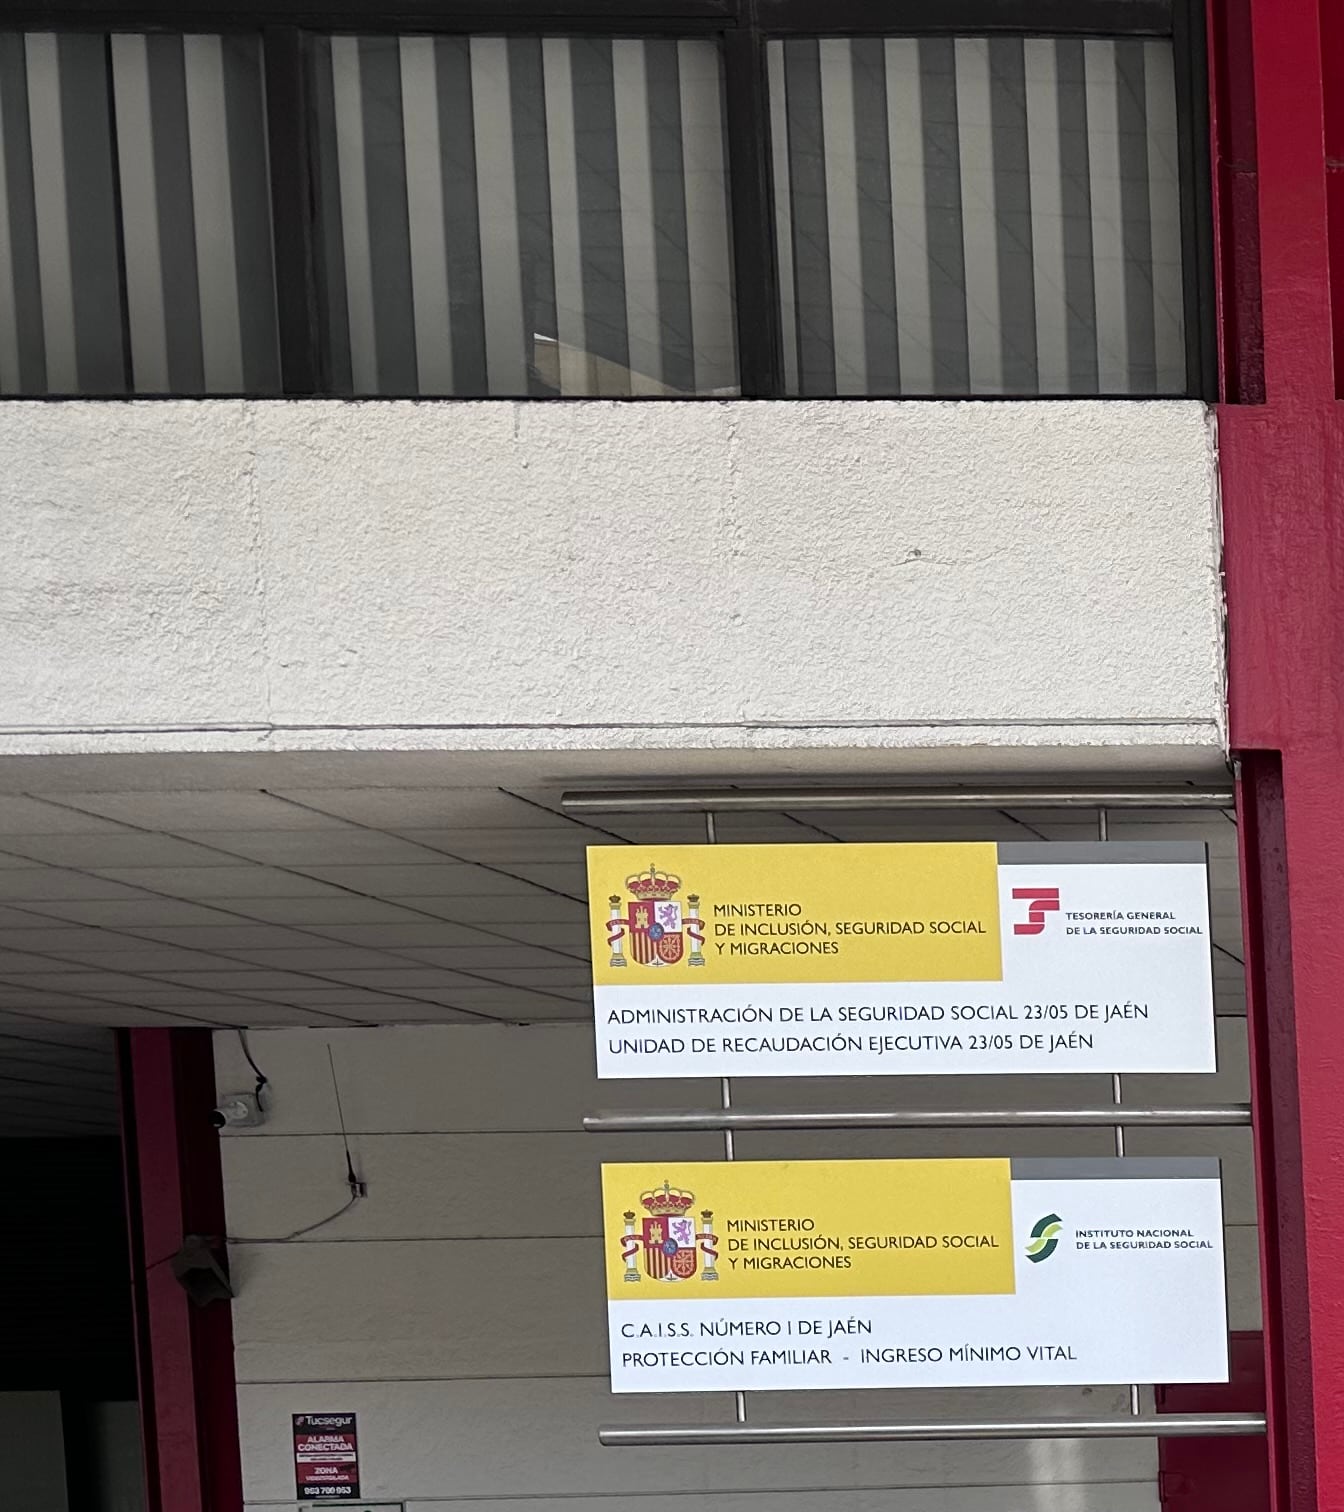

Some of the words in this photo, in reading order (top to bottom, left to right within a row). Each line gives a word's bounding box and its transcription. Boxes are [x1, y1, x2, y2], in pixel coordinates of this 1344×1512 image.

[714, 903, 802, 917] MINISTERIO
[1065, 910, 1124, 920] TESORERÍA
[1127, 911, 1176, 920] GENERAL
[714, 923, 735, 936] DE
[740, 920, 831, 937] INCLUSIÓN,
[836, 921, 925, 935] SEGURIDAD
[929, 921, 987, 934] SOCIAL
[1066, 927, 1080, 935] DE
[1083, 926, 1097, 935] LA
[1100, 926, 1161, 935] SEGURIDAD
[1164, 926, 1203, 935] SOCIAL
[715, 943, 726, 955] Y
[730, 941, 839, 955] MIGRACIONES
[607, 1004, 773, 1024] ADMINISTRACIÓN
[779, 1007, 803, 1022] DE
[810, 1007, 833, 1022] LA
[838, 1006, 945, 1022] SEGURIDAD
[950, 1005, 1019, 1020] SOCIAL
[1024, 1004, 1068, 1020] 23/05
[1075, 1005, 1099, 1019] DE
[1103, 1001, 1149, 1023] JAÉN
[608, 1038, 685, 1054] UNIDAD
[692, 1038, 716, 1053] DE
[722, 1033, 862, 1053] RECAUDACIÓN
[869, 1035, 963, 1054] EJECUTIVA
[968, 1034, 1013, 1050] 23/05
[1019, 1034, 1044, 1049] DE
[1048, 1031, 1093, 1053] JAÉN
[727, 1218, 815, 1232] MINISTERIO
[1075, 1229, 1134, 1238] INSTITUTO
[1136, 1229, 1194, 1238] NACIONAL
[728, 1238, 749, 1251] DE
[754, 1234, 844, 1251] INCLUSIÓN,
[848, 1236, 937, 1249] SEGURIDAD
[942, 1235, 1000, 1248] SOCIAL
[1076, 1241, 1091, 1249] DE
[1093, 1241, 1107, 1249] LA
[1109, 1241, 1172, 1249] SEGURIDAD
[1174, 1240, 1214, 1249] SOCIAL
[728, 1258, 738, 1270] Y
[743, 1256, 852, 1270] MIGRACIONES
[621, 1322, 694, 1338] C.A.I.S.S.
[700, 1318, 781, 1336] NÚMERO
[798, 1320, 823, 1335] DE
[827, 1316, 872, 1338] JAÉN
[623, 1347, 744, 1367] PROTECCIÓN
[751, 1349, 833, 1365] FAMILIAR
[861, 1347, 943, 1363] INGRESO
[949, 1343, 1021, 1362] MÍNIMO
[1026, 1345, 1078, 1361] VITAL
[305, 1416, 352, 1427] Tucsegur
[298, 1442, 353, 1451] CONECTADA
